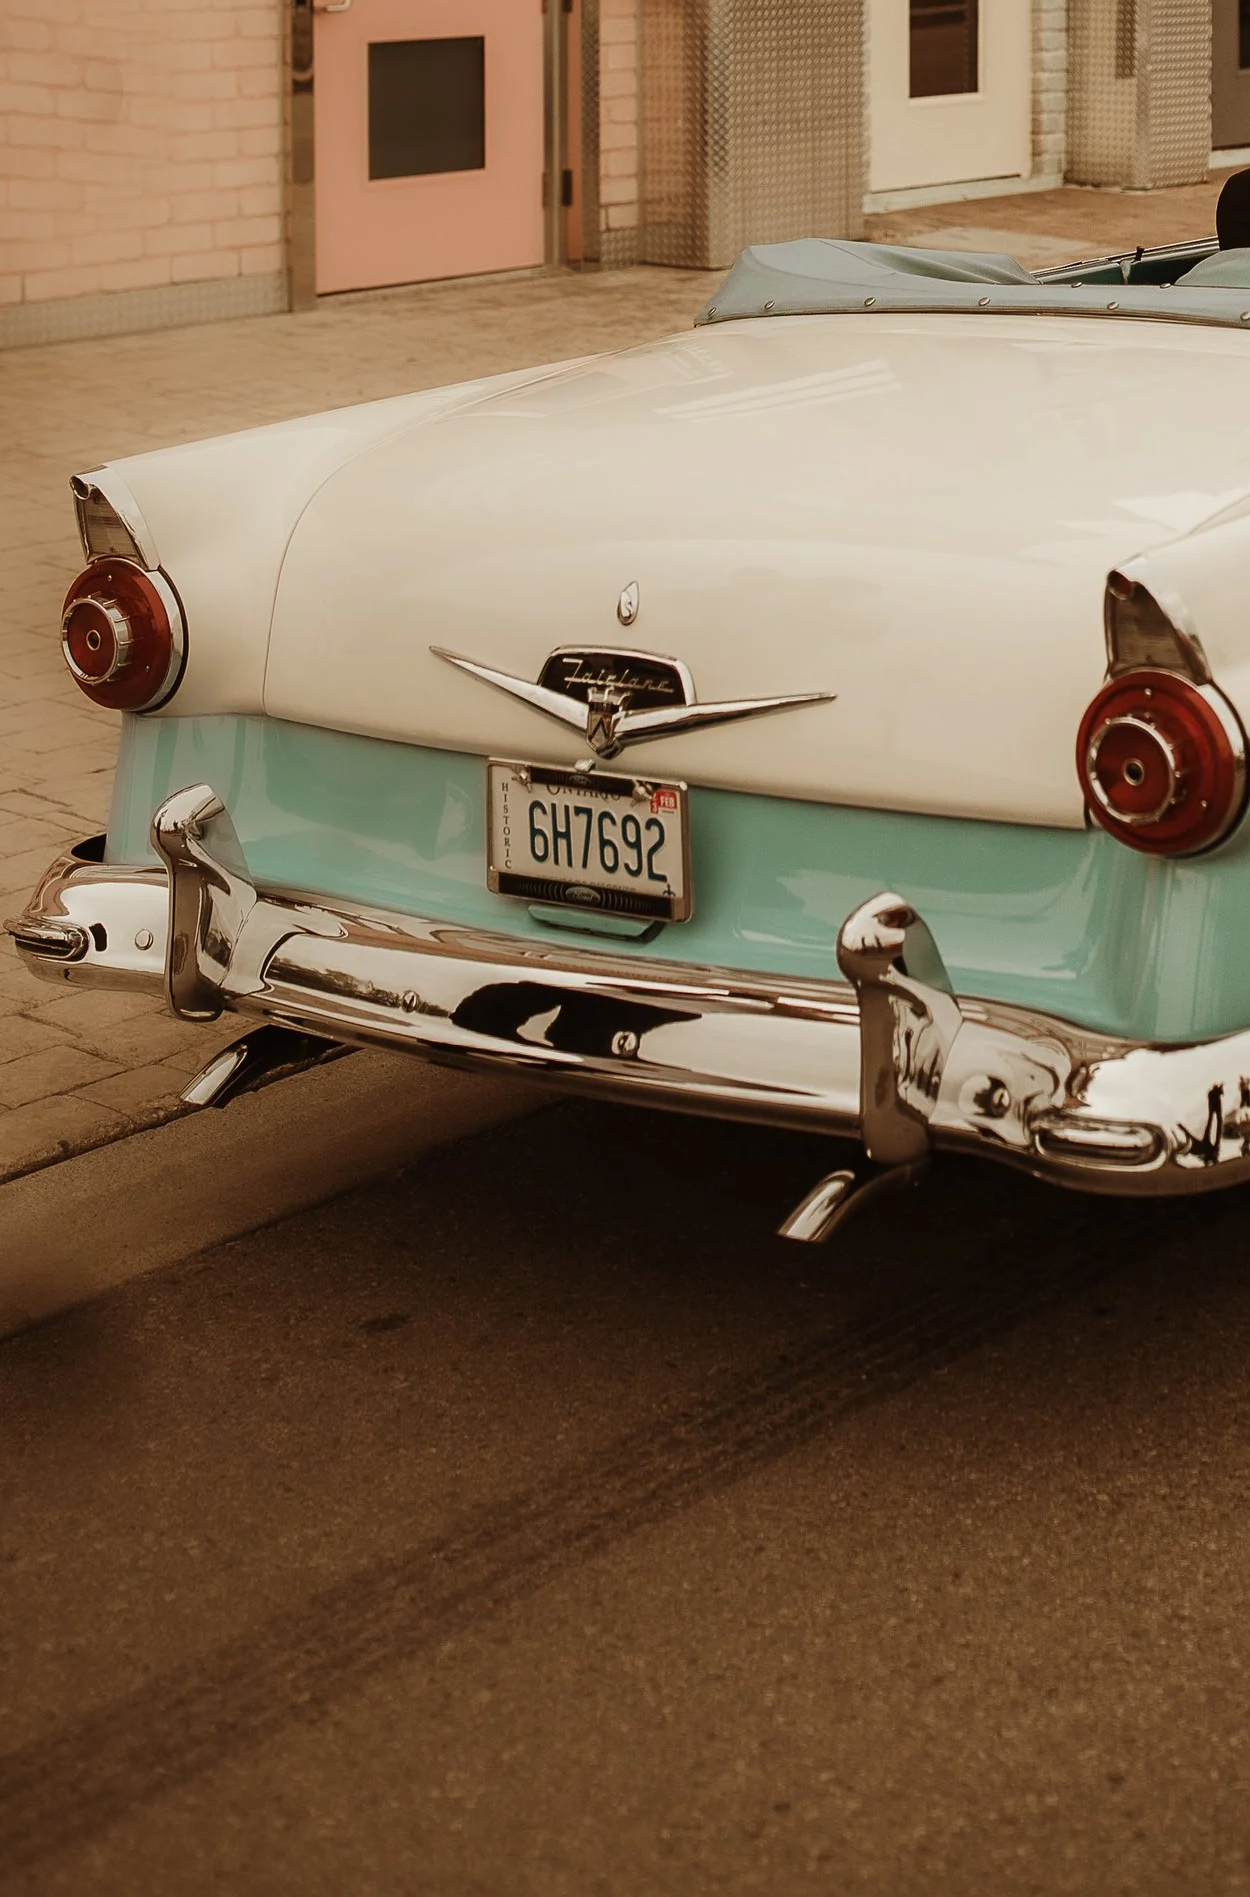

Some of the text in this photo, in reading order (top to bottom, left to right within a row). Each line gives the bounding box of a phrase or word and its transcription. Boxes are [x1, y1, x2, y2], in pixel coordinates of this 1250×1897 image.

[562, 657, 675, 693] Fairlane
[501, 782, 512, 869] HISTORIC
[528, 800, 668, 883] 6H7692
